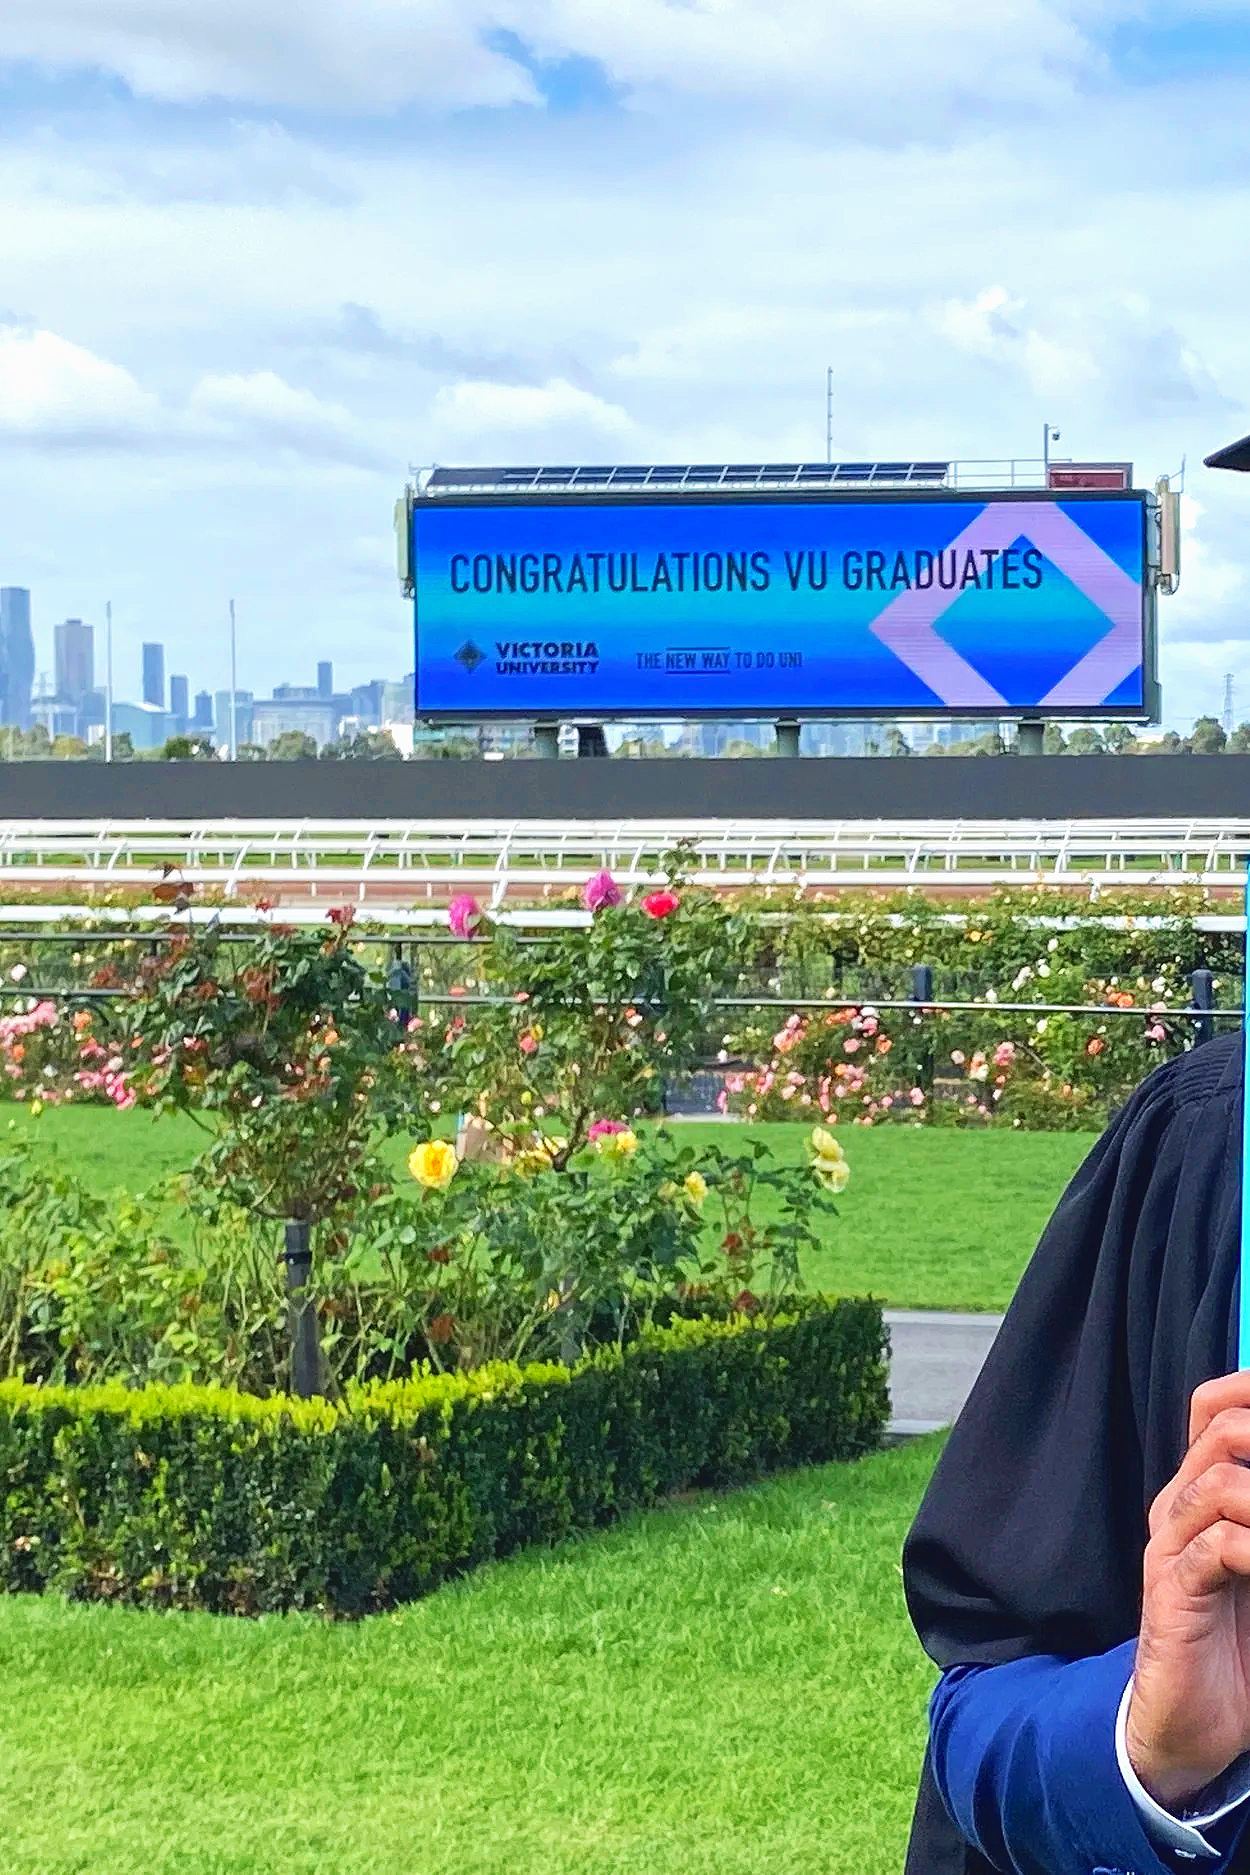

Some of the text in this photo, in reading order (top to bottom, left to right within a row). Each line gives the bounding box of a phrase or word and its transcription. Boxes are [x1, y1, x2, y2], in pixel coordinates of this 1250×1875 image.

[450, 548, 1043, 593] CONGRATULATIONS VU GRADUATES
[496, 642, 599, 658] VICTORIA
[496, 661, 598, 675] UNIVERSITY
[636, 652, 802, 669] THE NEW WAY TO DO UNI
